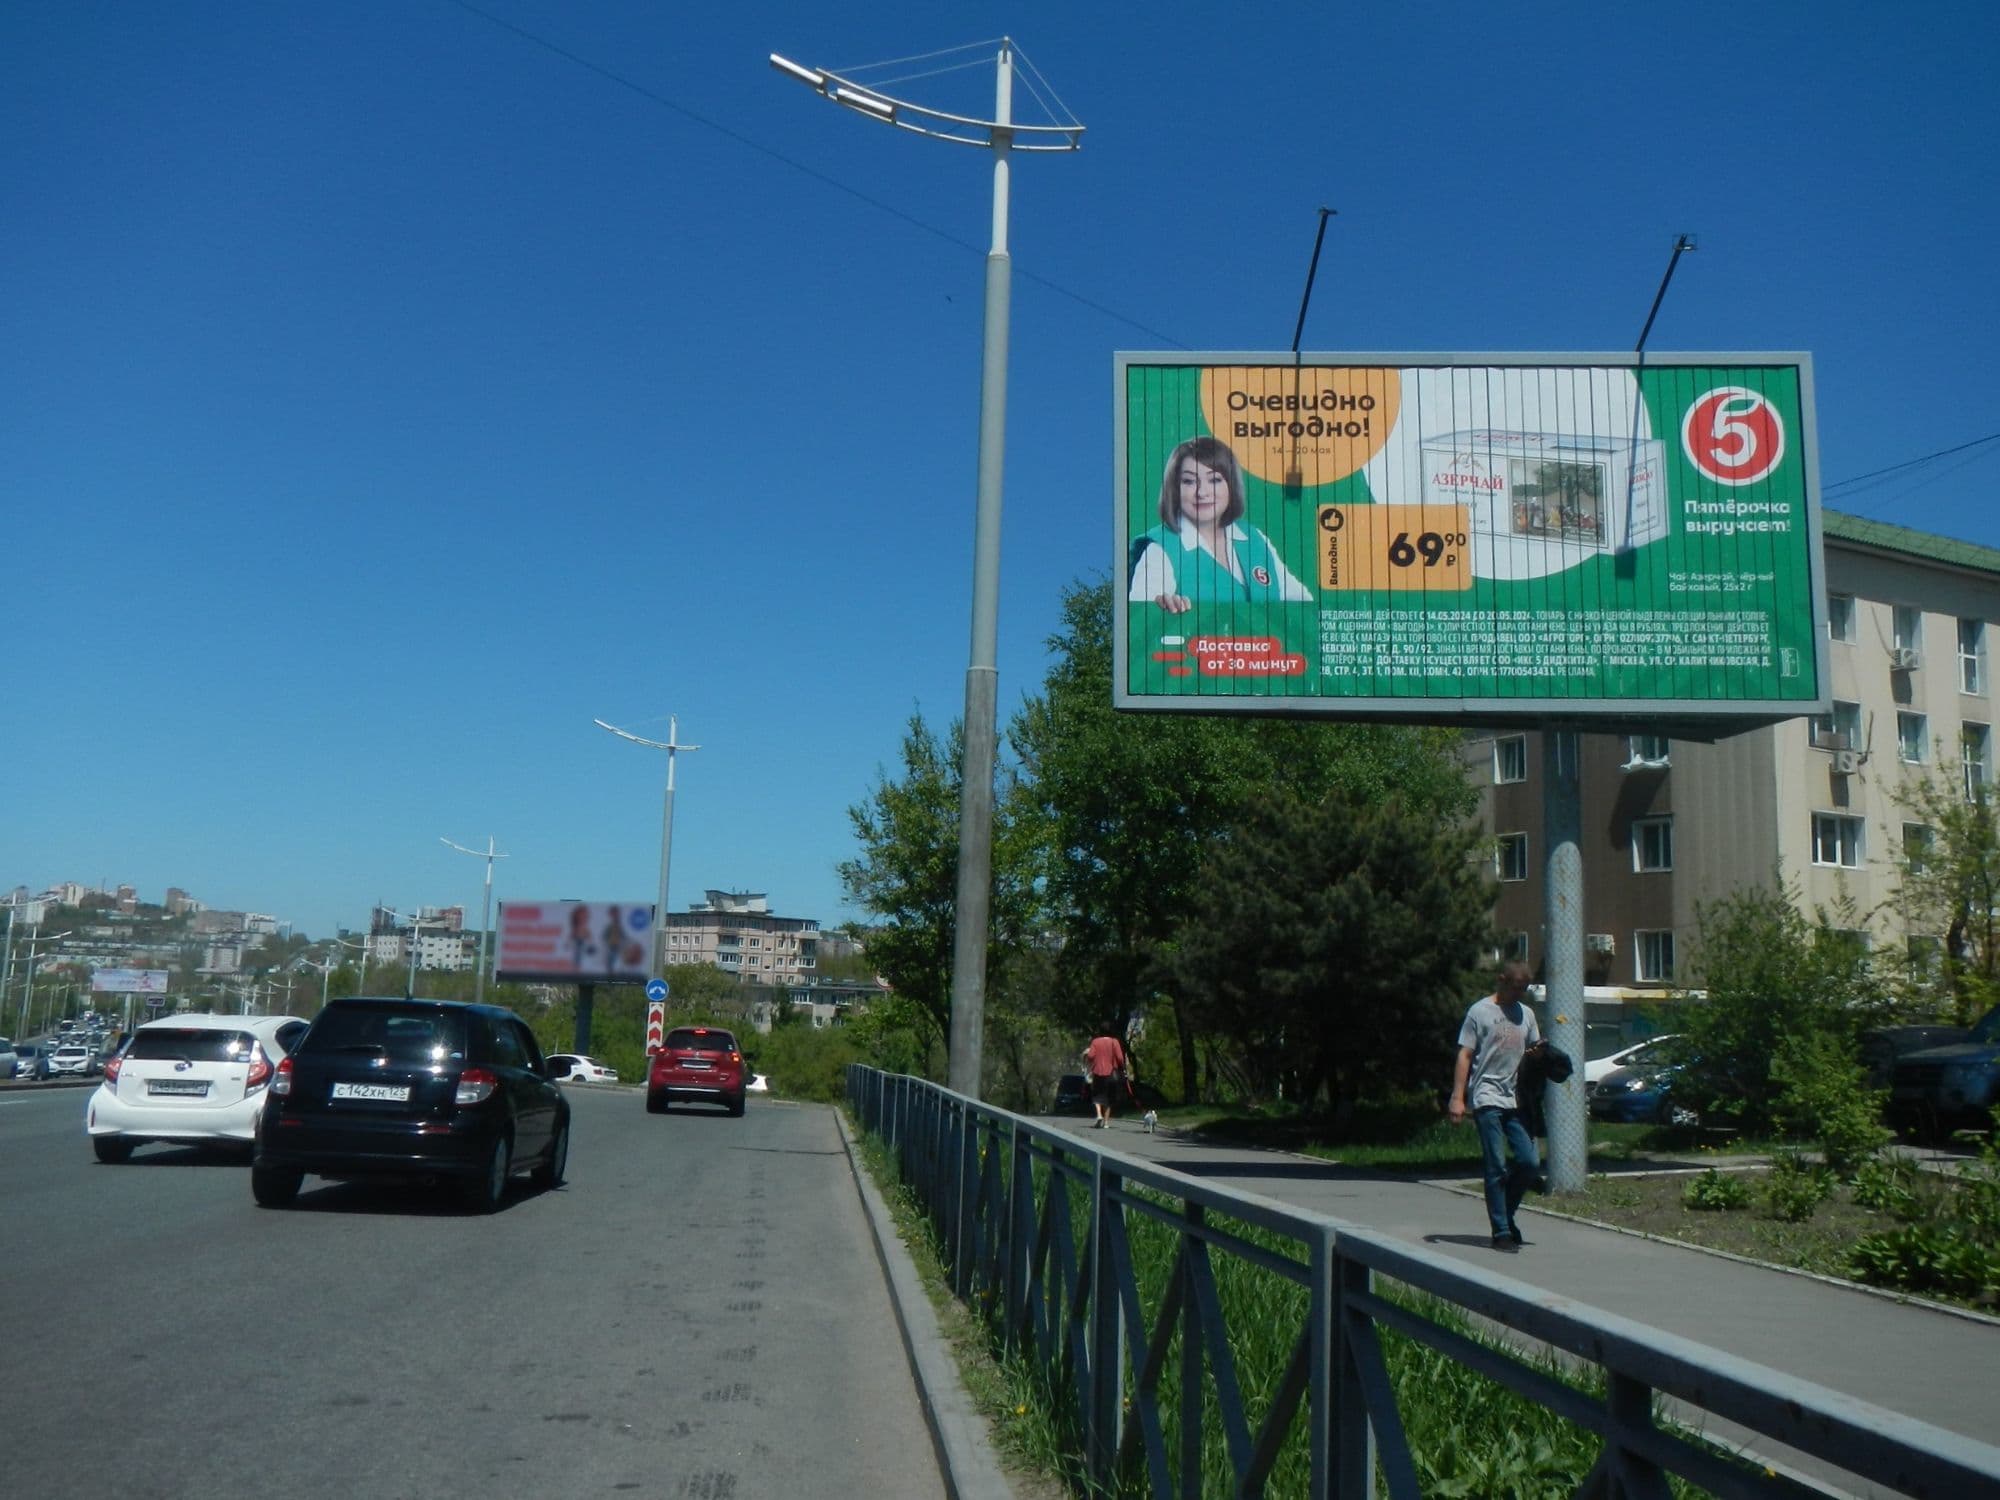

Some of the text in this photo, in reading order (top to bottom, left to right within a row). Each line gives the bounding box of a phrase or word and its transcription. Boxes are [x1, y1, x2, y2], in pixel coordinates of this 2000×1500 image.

[1227, 389, 1375, 411] Очевидно
[1234, 415, 1370, 438] выгодно!
[1311, 447, 1331, 455] мая
[1432, 472, 1504, 490] АЗЕРЧАЙ
[1684, 499, 1790, 517] Пятёрочка
[1686, 520, 1791, 535] выручает!
[1388, 532, 1466, 567] 69 90
[1328, 536, 1338, 585] Выгодно
[1669, 571, 1686, 580] Чай
[1321, 610, 1372, 621] ПРЕДЛОЖЕНИ
[1672, 622, 1724, 632] ПРЕДЛОЖЕНИ
[1195, 640, 1271, 653] Доставка
[1207, 658, 1298, 672] от 30 минут
